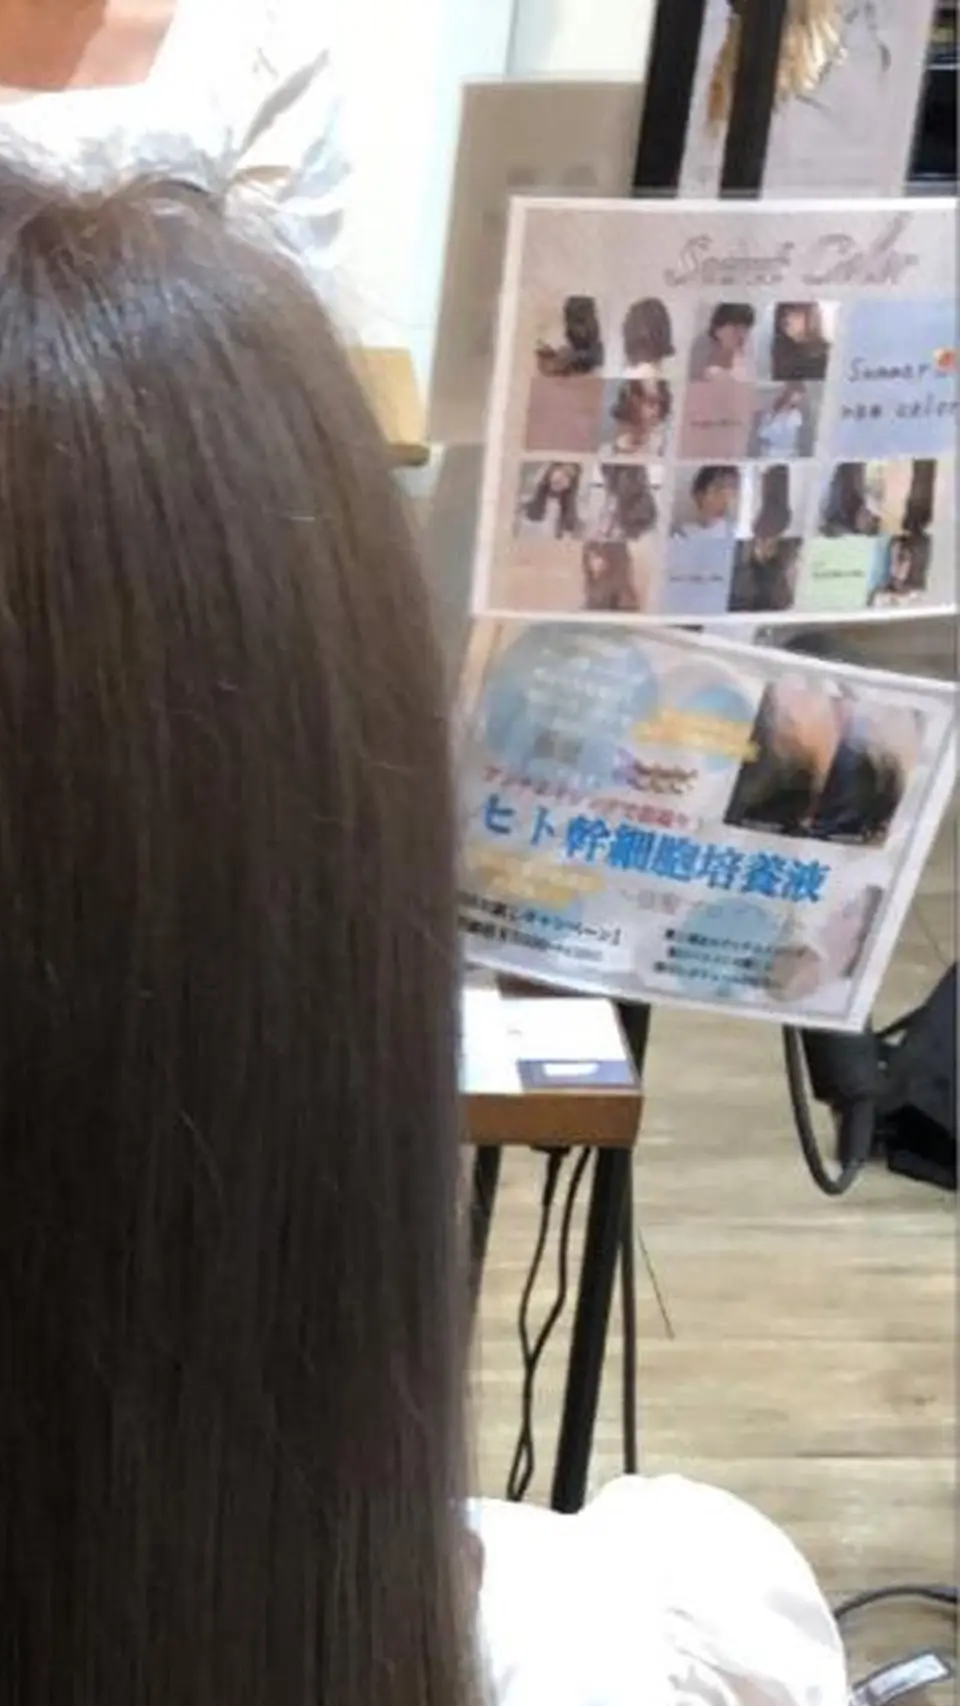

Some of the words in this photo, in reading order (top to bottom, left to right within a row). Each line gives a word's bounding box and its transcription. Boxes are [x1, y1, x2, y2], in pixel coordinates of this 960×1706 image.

[483, 792, 831, 903] ヒト幹細胞培養液
